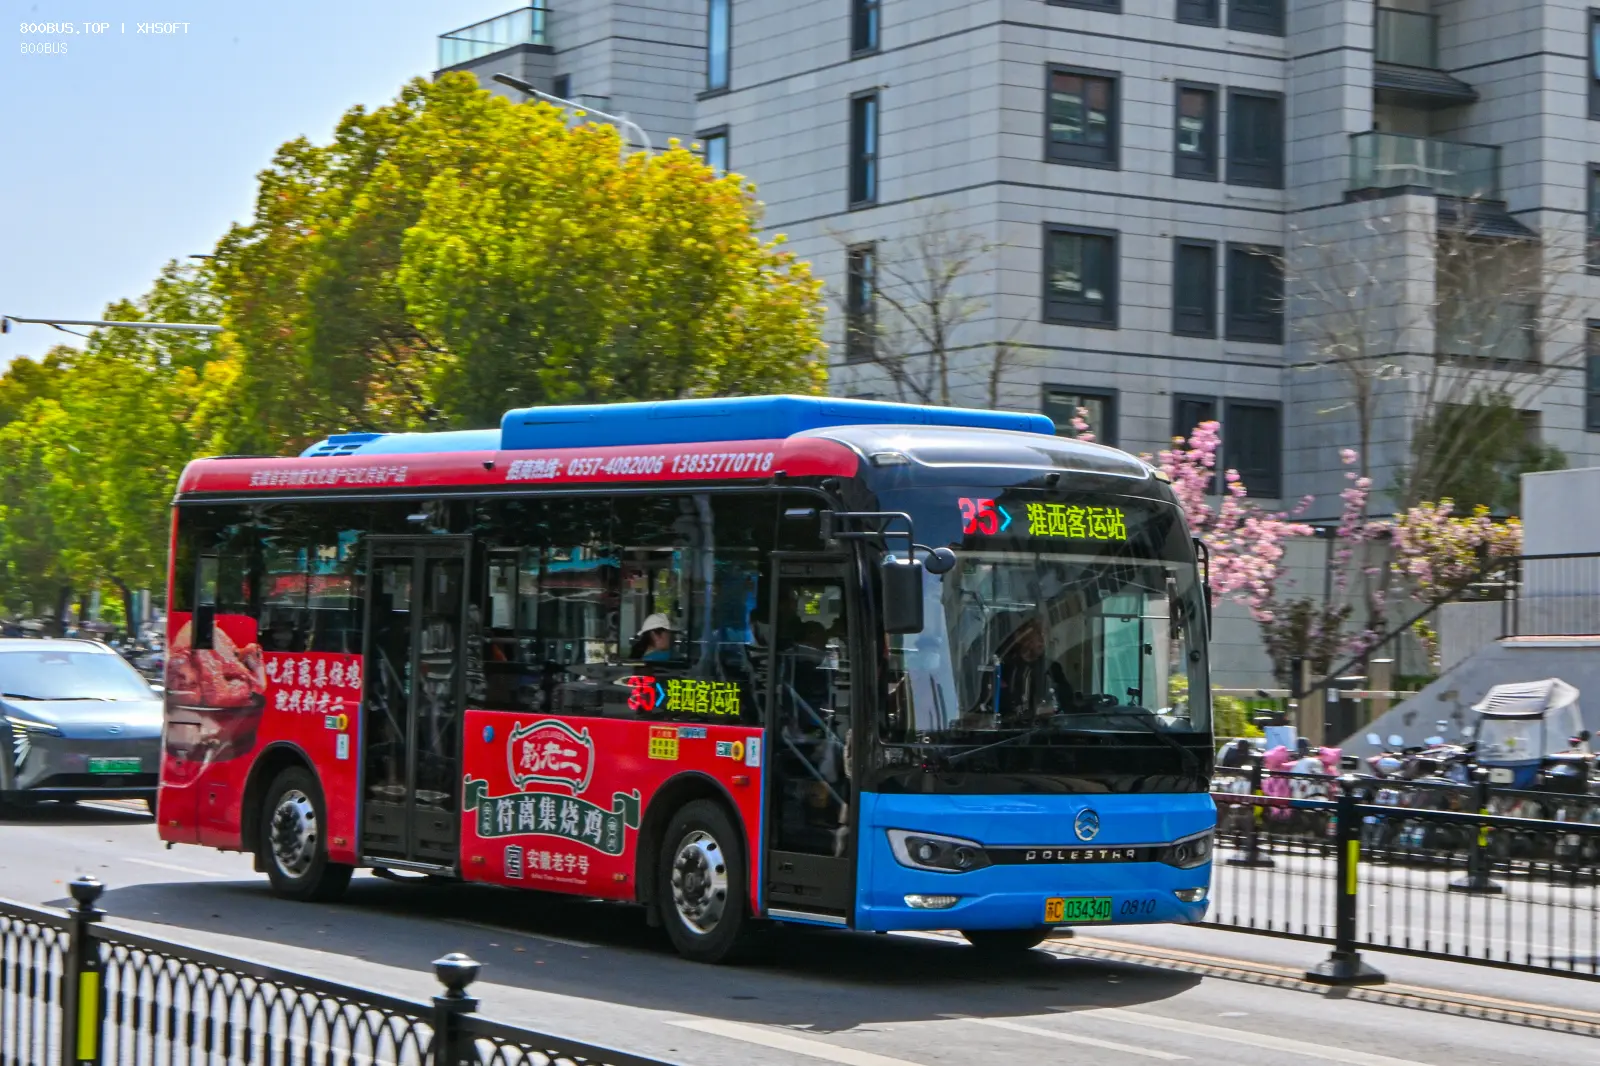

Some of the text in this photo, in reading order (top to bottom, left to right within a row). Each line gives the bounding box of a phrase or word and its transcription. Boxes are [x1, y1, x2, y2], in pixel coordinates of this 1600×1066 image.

[567, 455, 665, 477] 0557-4082006
[671, 452, 774, 474] 13855770718
[958, 497, 1128, 541] 35 淮西客运站
[627, 675, 742, 716] 35 淮西客运站
[495, 796, 605, 846] 符离集烧鸡
[526, 848, 590, 877] 安徽老字号
[1025, 849, 1136, 861] POLESTAR
[1120, 898, 1157, 916] 0810
